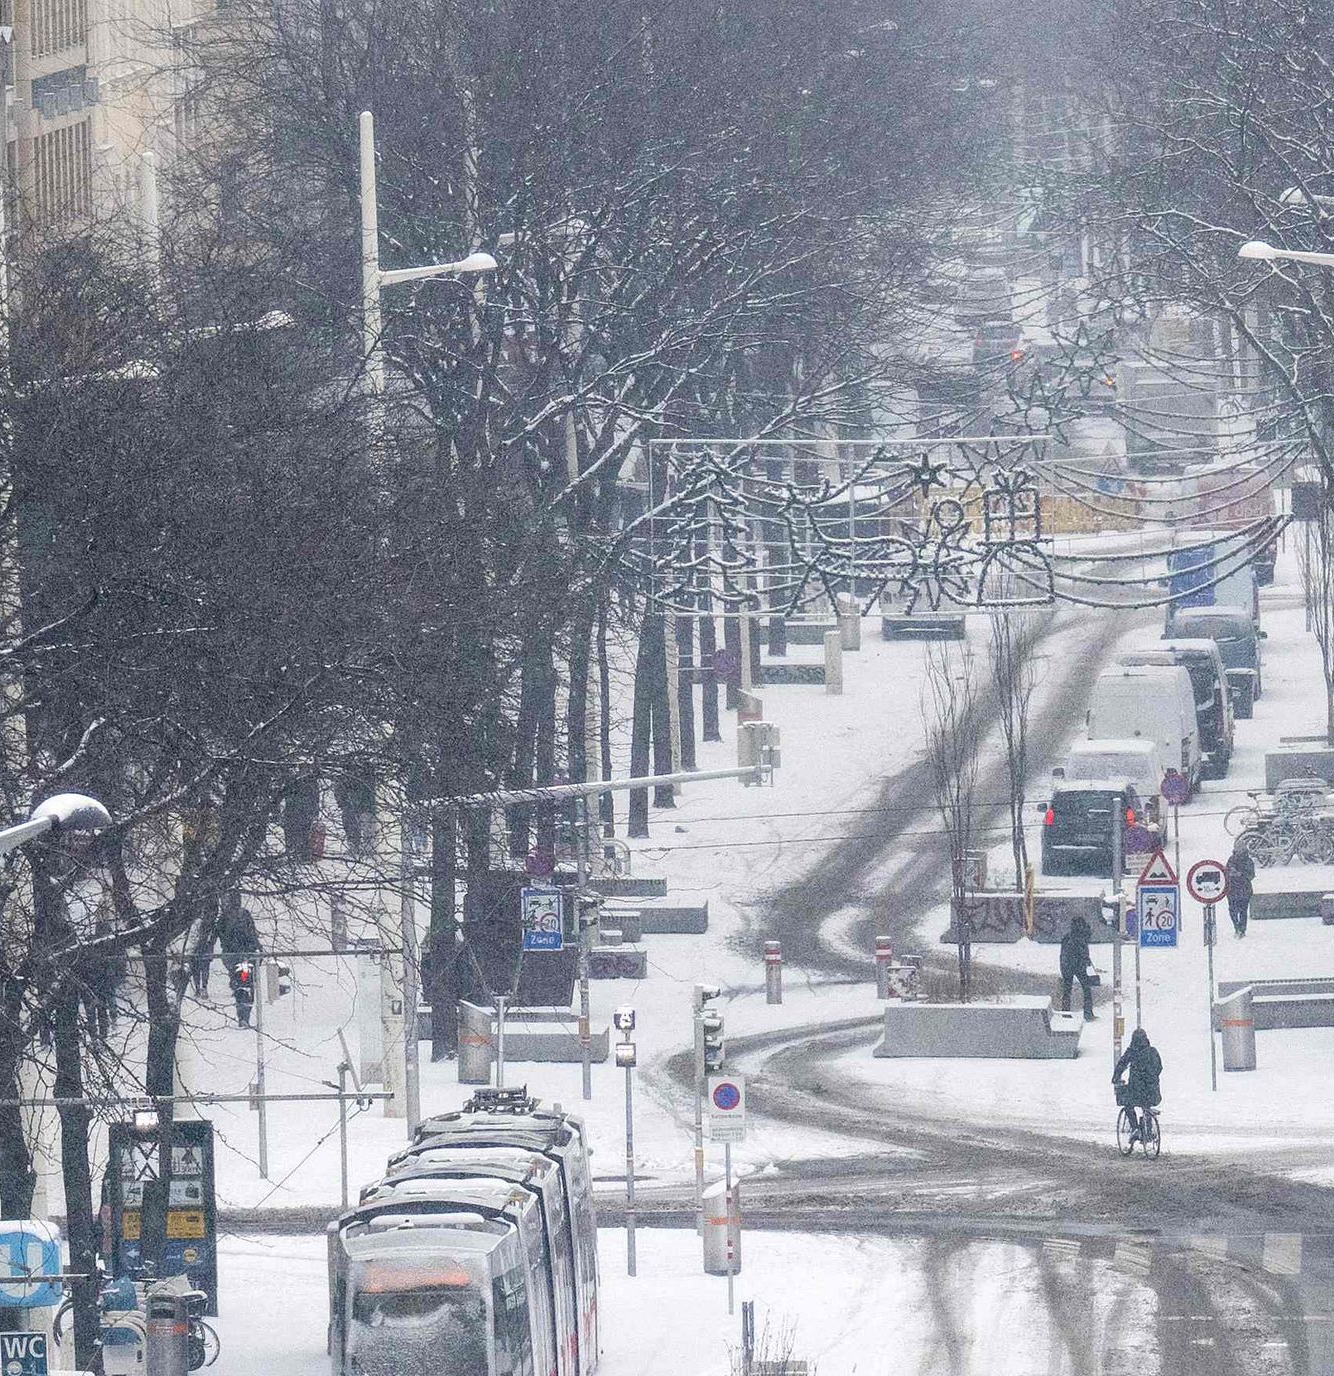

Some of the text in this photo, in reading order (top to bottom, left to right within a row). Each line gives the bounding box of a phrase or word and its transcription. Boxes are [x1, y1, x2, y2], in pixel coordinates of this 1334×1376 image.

[1161, 916, 1173, 927] 20
[1147, 933, 1171, 943] Zone
[3, 1336, 44, 1359] WC
